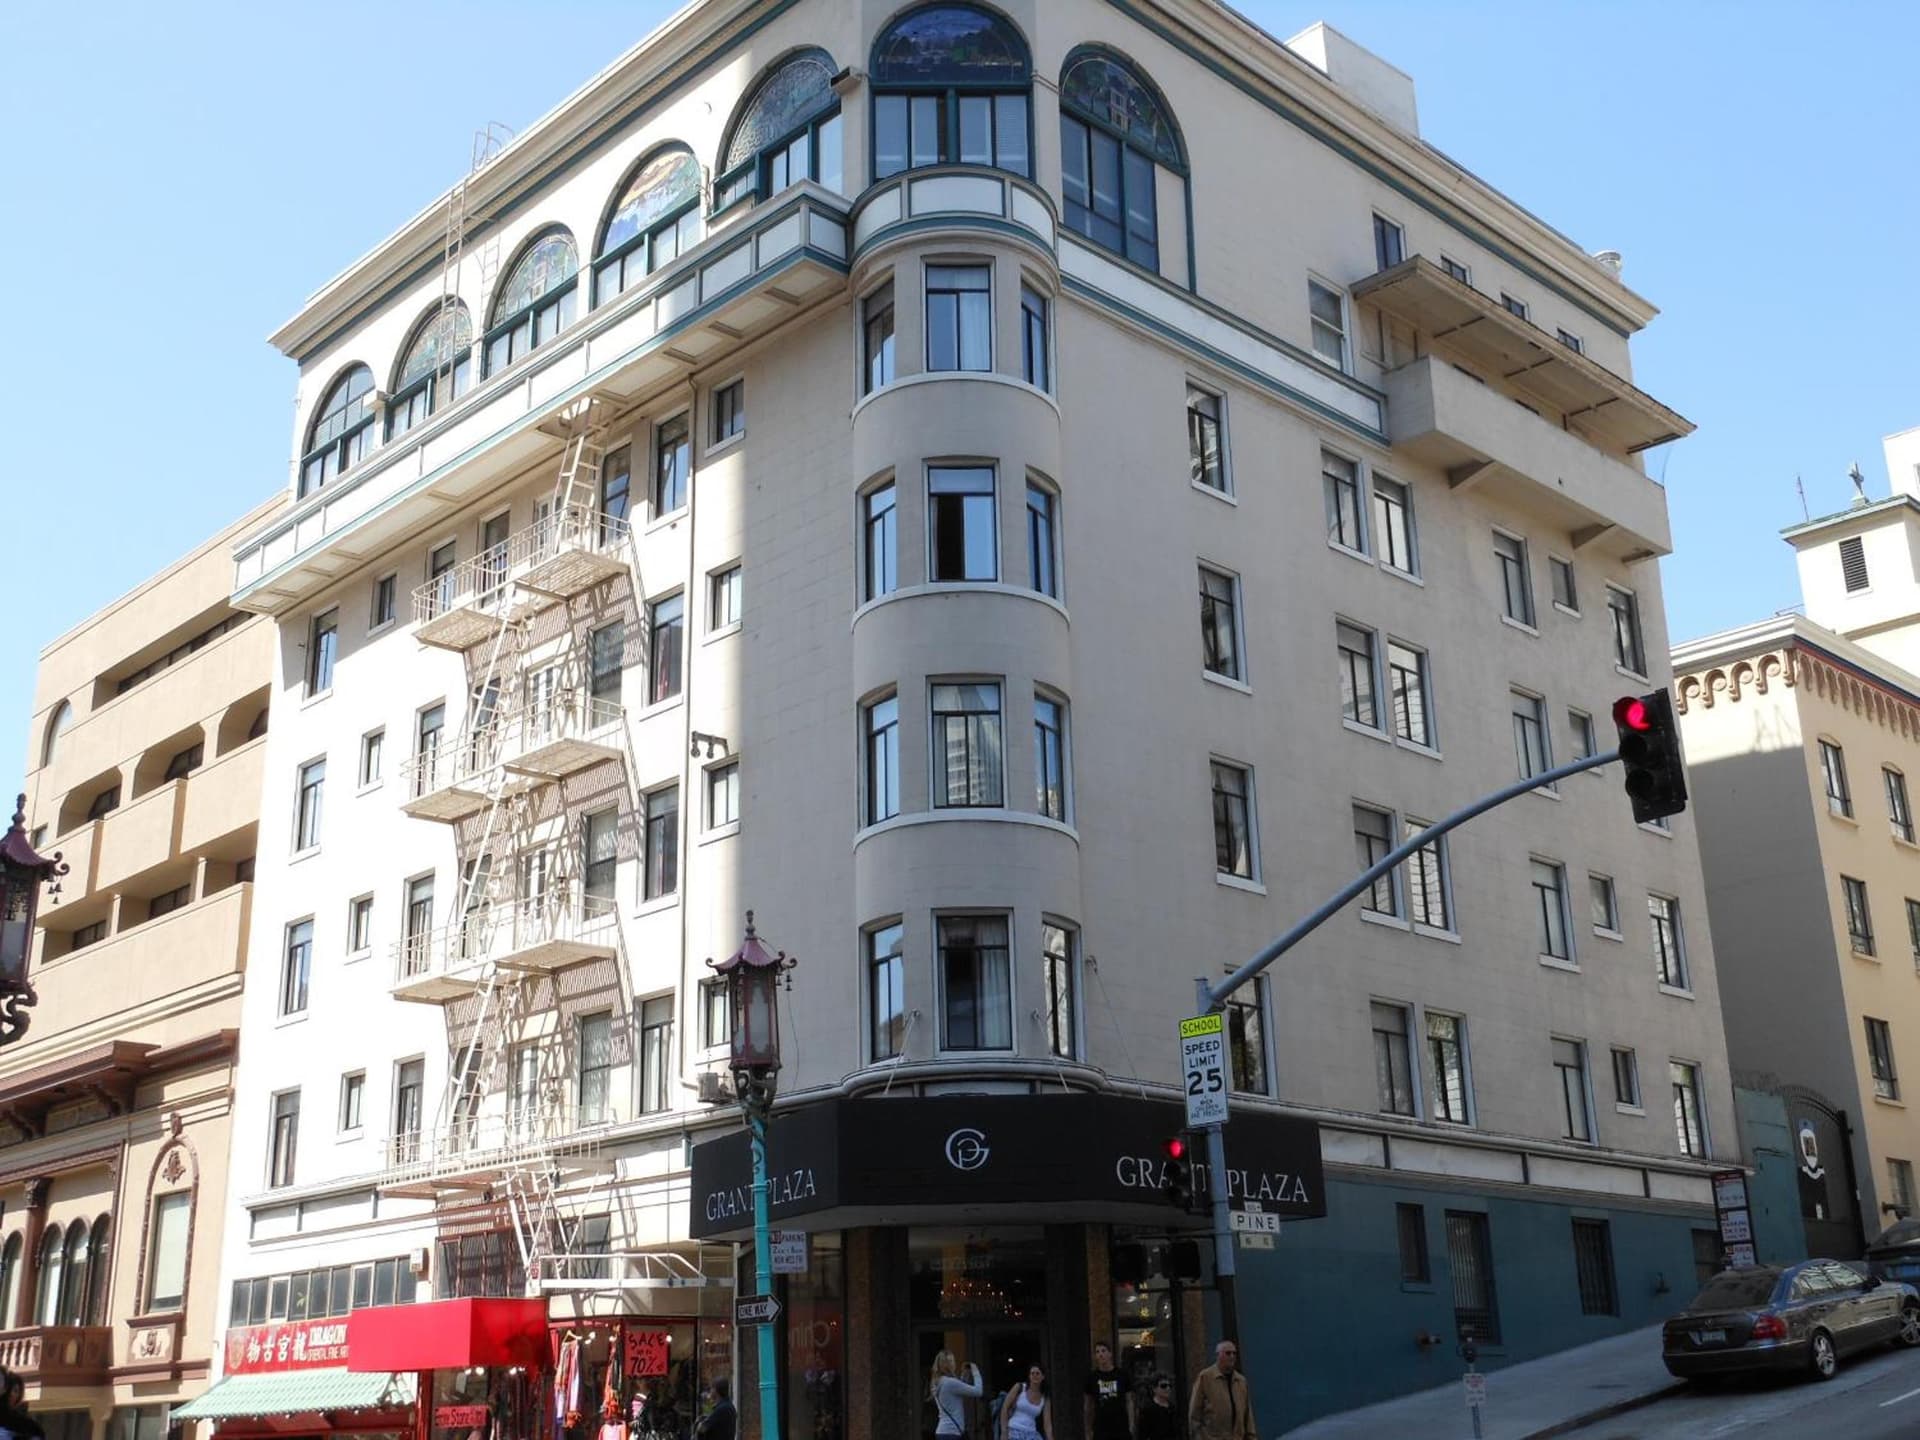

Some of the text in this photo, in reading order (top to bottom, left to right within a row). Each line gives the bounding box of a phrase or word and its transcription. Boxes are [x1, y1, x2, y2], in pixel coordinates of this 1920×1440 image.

[1182, 1018, 1219, 1034] SCHOOL
[1185, 1040, 1220, 1055] SPEED
[1189, 1055, 1216, 1068] LIMIT
[1187, 1067, 1223, 1096] 25
[1227, 1169, 1309, 1202] PLAZA
[1237, 1215, 1274, 1230] PINE
[740, 1303, 768, 1317] ONE WAY
[308, 1324, 348, 1346] DRAGON
